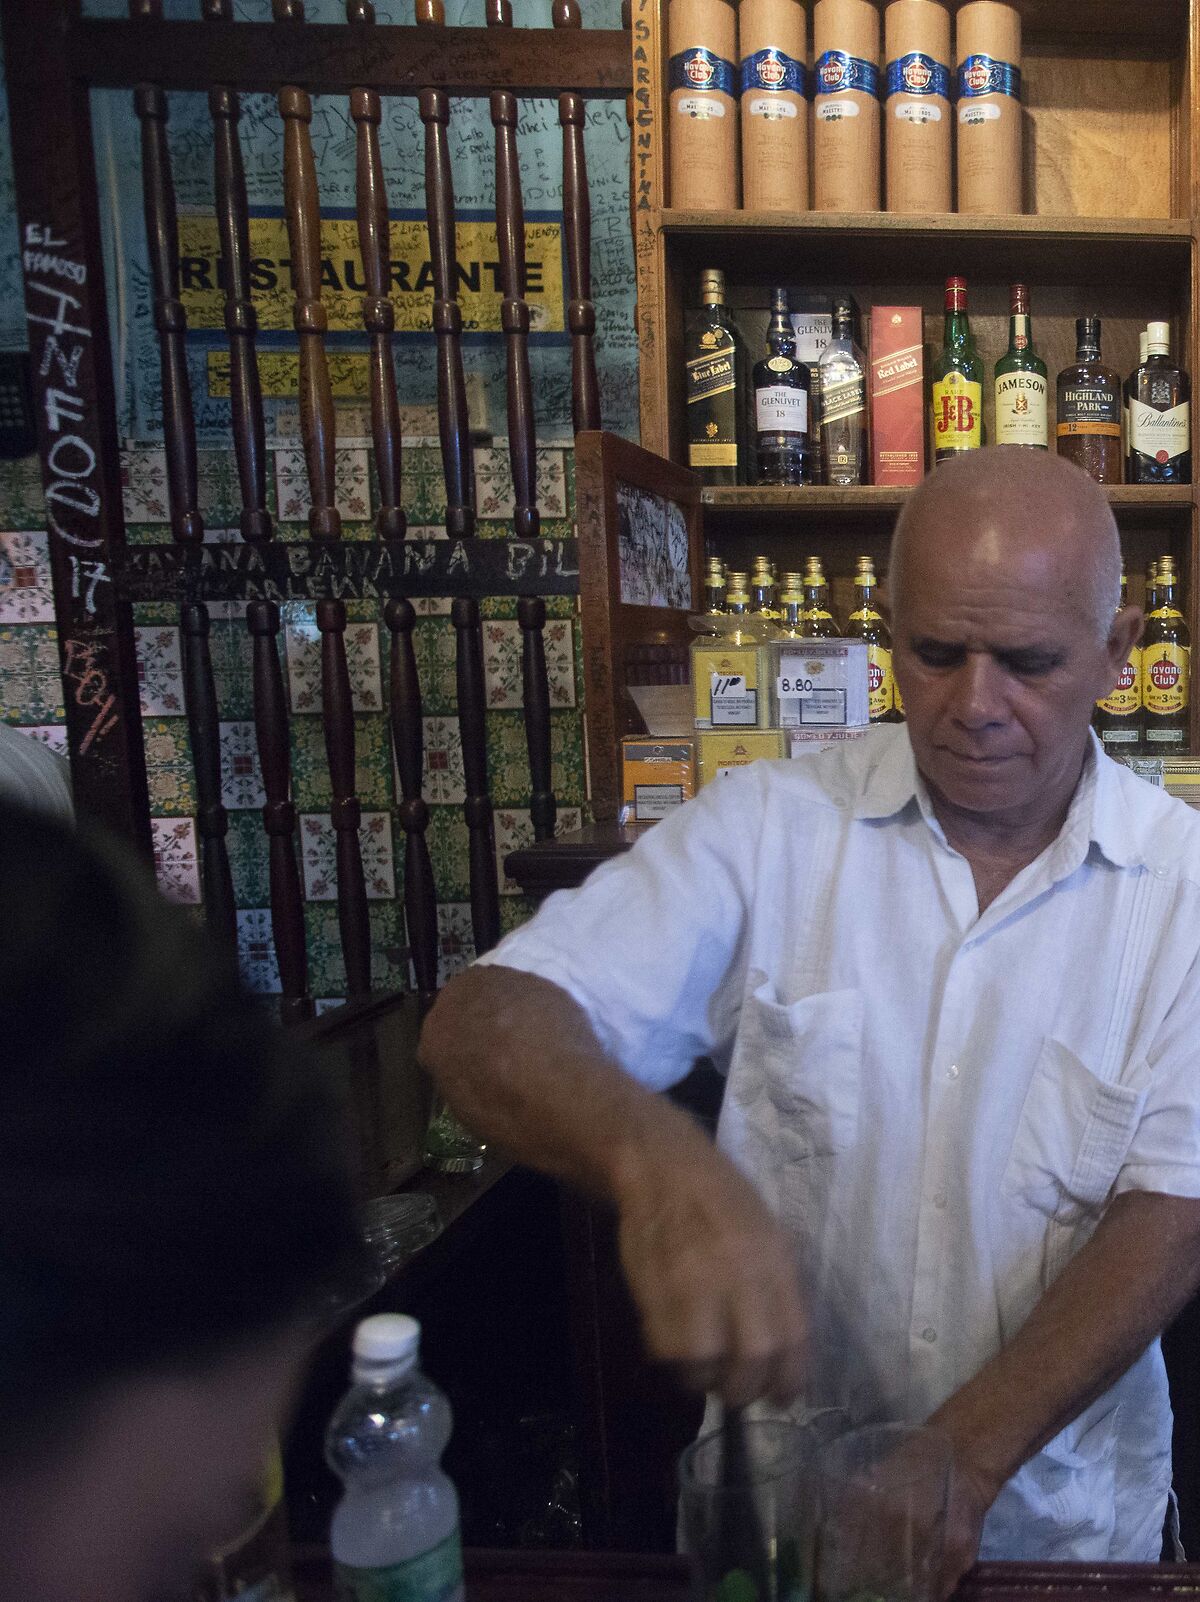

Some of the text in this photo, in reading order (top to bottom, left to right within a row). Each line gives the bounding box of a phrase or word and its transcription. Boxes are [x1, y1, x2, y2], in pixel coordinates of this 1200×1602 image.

[684, 62, 714, 74] Havana
[757, 63, 786, 75] Havana
[820, 66, 846, 76] Havana
[902, 67, 932, 79] Havana
[690, 69, 708, 80] Club
[762, 70, 781, 81] Club
[824, 73, 840, 83] Club
[964, 69, 991, 79] Havana
[908, 74, 926, 86] Club
[969, 76, 985, 86] Club
[25, 223, 67, 246] EL
[797, 326, 832, 335] GLENLIV
[815, 339, 828, 349] 18
[709, 361, 732, 376] Label
[877, 367, 895, 379] Red
[894, 359, 918, 373] Label
[997, 378, 1046, 396] JAMESON
[761, 397, 801, 406] GLENLIVET
[1065, 391, 1113, 402] HIGHLAND
[1076, 402, 1101, 411] PARK
[776, 409, 786, 418] 18
[937, 395, 975, 433] J&B
[1067, 423, 1077, 431] 12
[1148, 664, 1182, 675] Havana
[782, 678, 813, 692] 8.80
[1117, 674, 1132, 685] lub
[1153, 674, 1175, 685] Club
[1119, 694, 1126, 704] 3
[1161, 693, 1168, 703] 3
